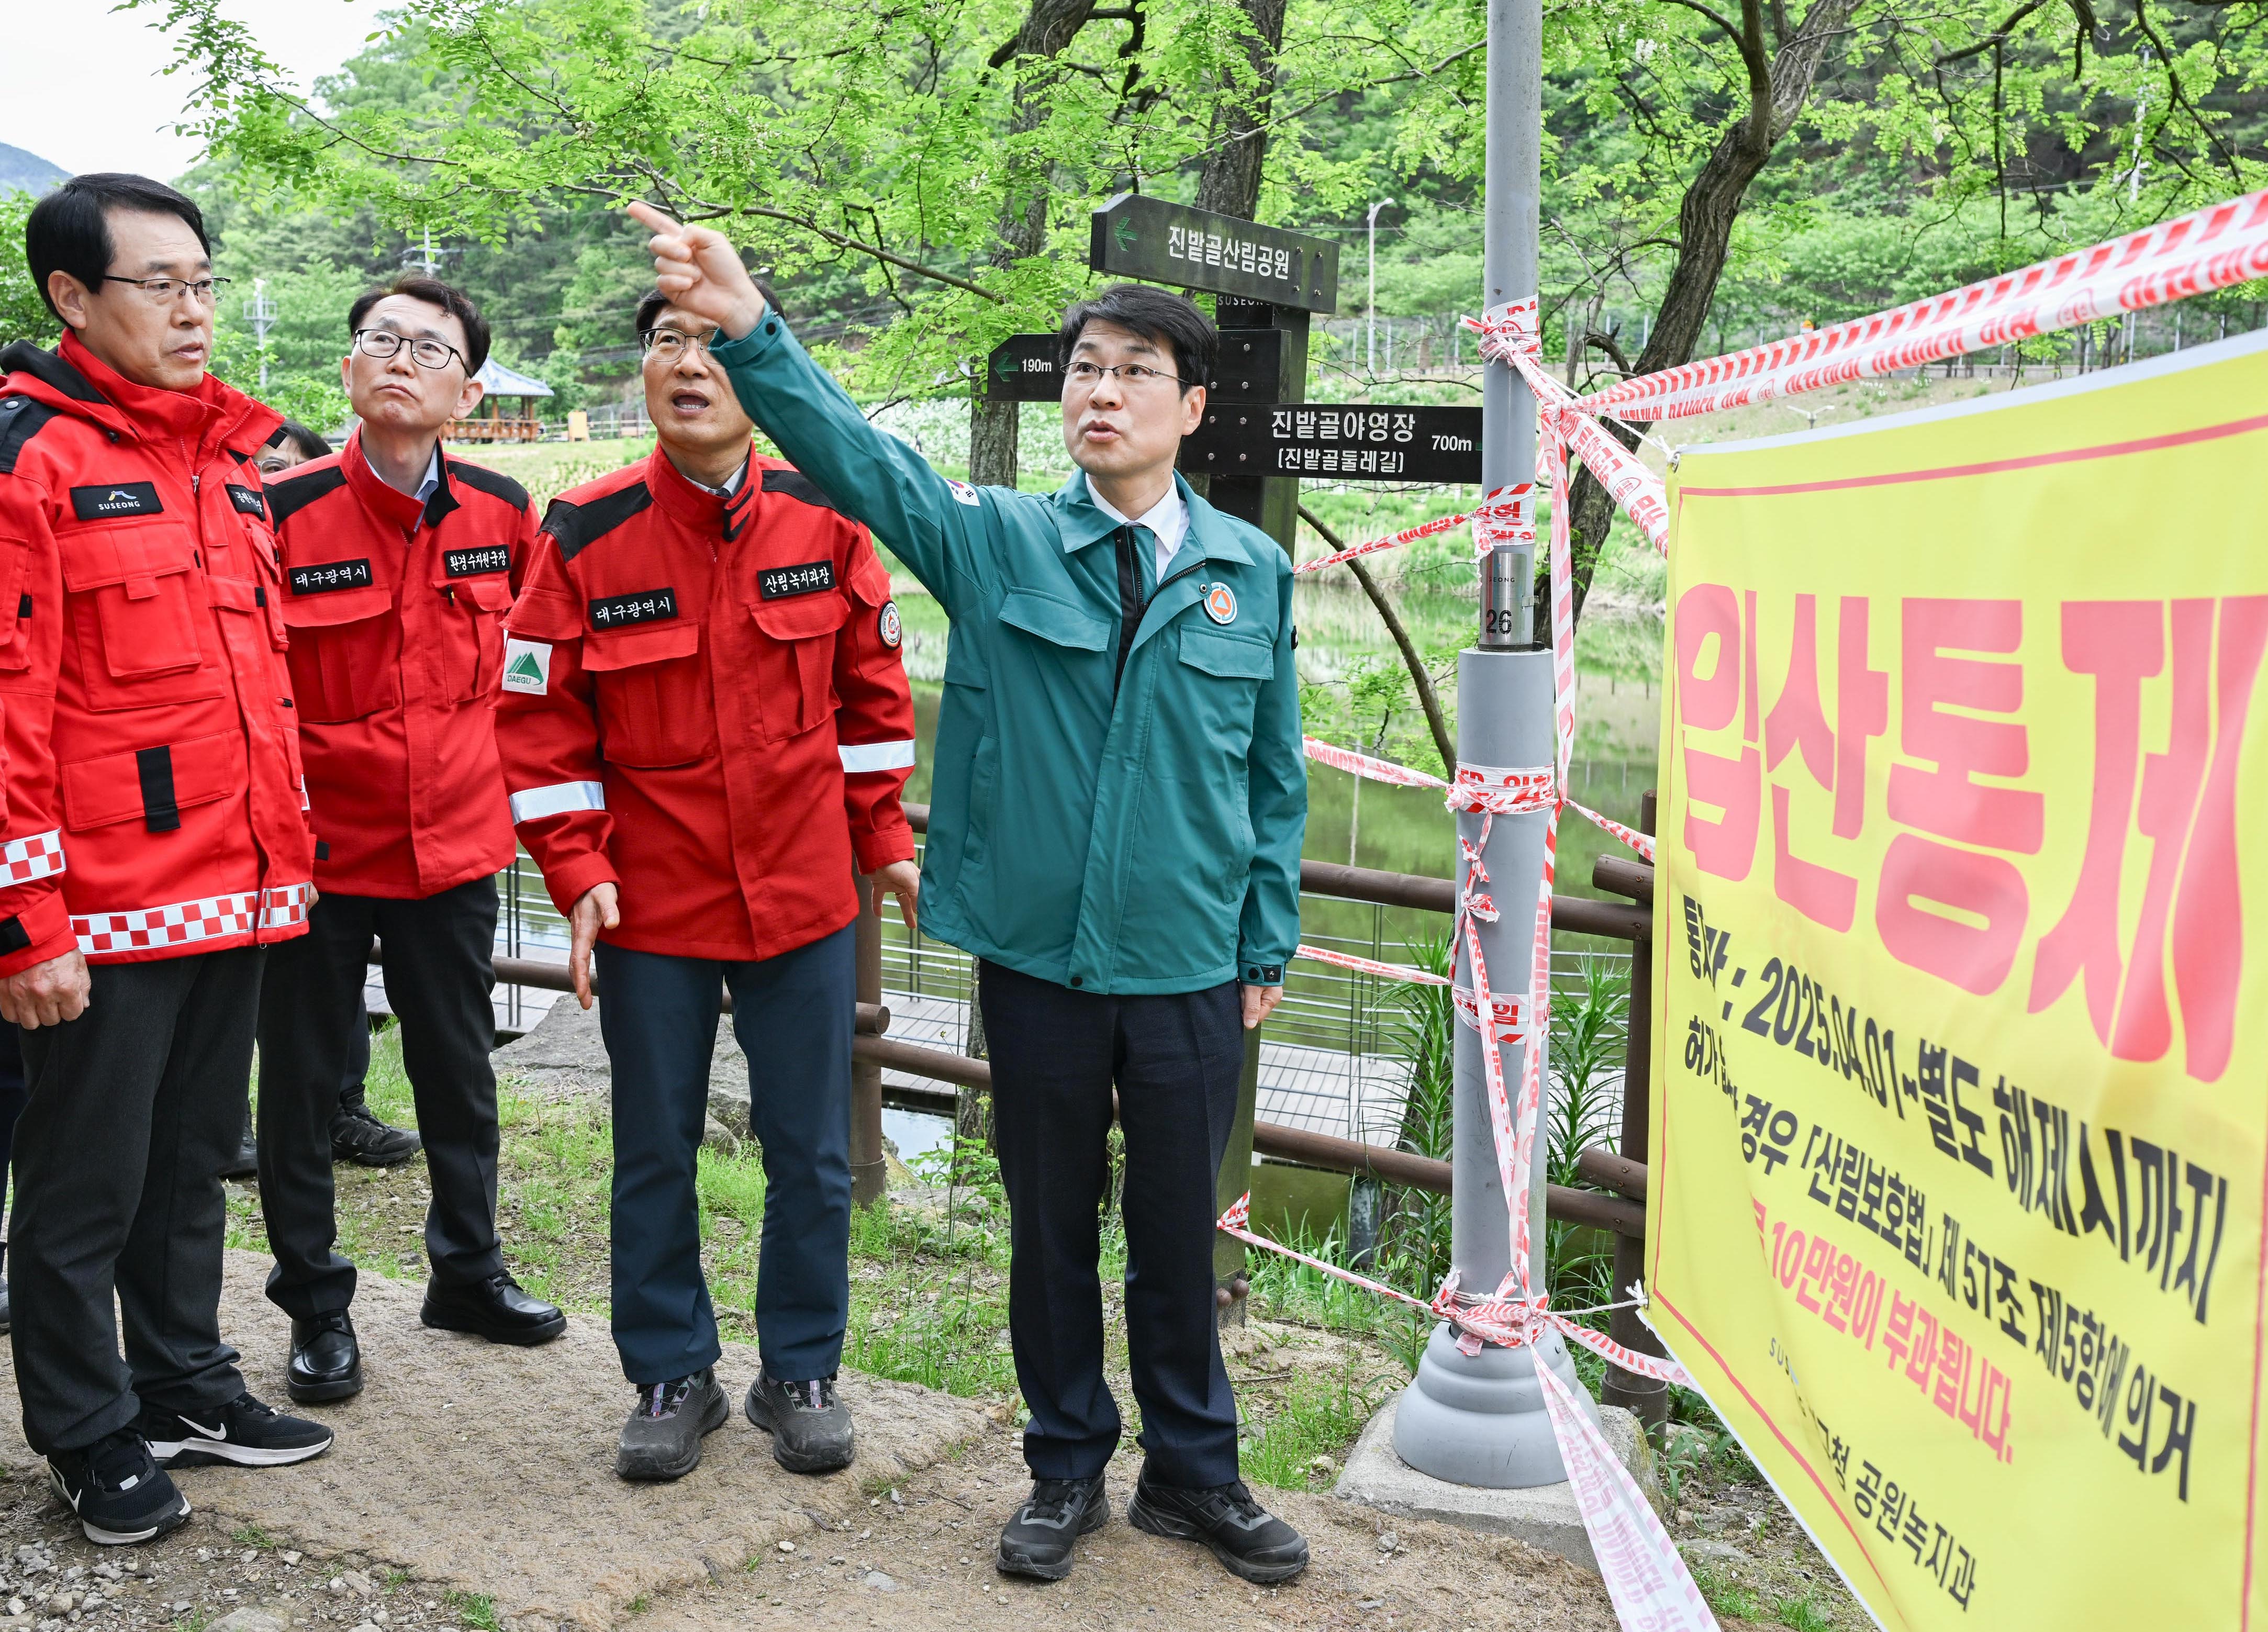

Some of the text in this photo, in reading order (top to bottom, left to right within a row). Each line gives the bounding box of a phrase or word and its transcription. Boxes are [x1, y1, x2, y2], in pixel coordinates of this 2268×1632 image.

[1169, 226, 1289, 280] 진밭골산림공원
[1022, 358, 1052, 372] 190m
[1271, 411, 1472, 451] 진밭골야영장 700m
[98, 501, 140, 510] SUSEONG
[450, 550, 506, 572] 환경수자원국장
[295, 565, 366, 588] 대구광역시
[765, 569, 830, 592] 산림녹지과장
[596, 597, 671, 623] 대구광역시
[1486, 609, 1512, 634] 26
[507, 675, 531, 685] DAEGU
[1741, 1094, 1797, 1175] 경우
[2118, 1365, 2196, 1503] 의거
[1772, 1221, 1886, 1351] 10만원이
[1883, 1290, 2013, 1465] 부과됩니다.
[1855, 1460, 1976, 1612] 공원녹지과
